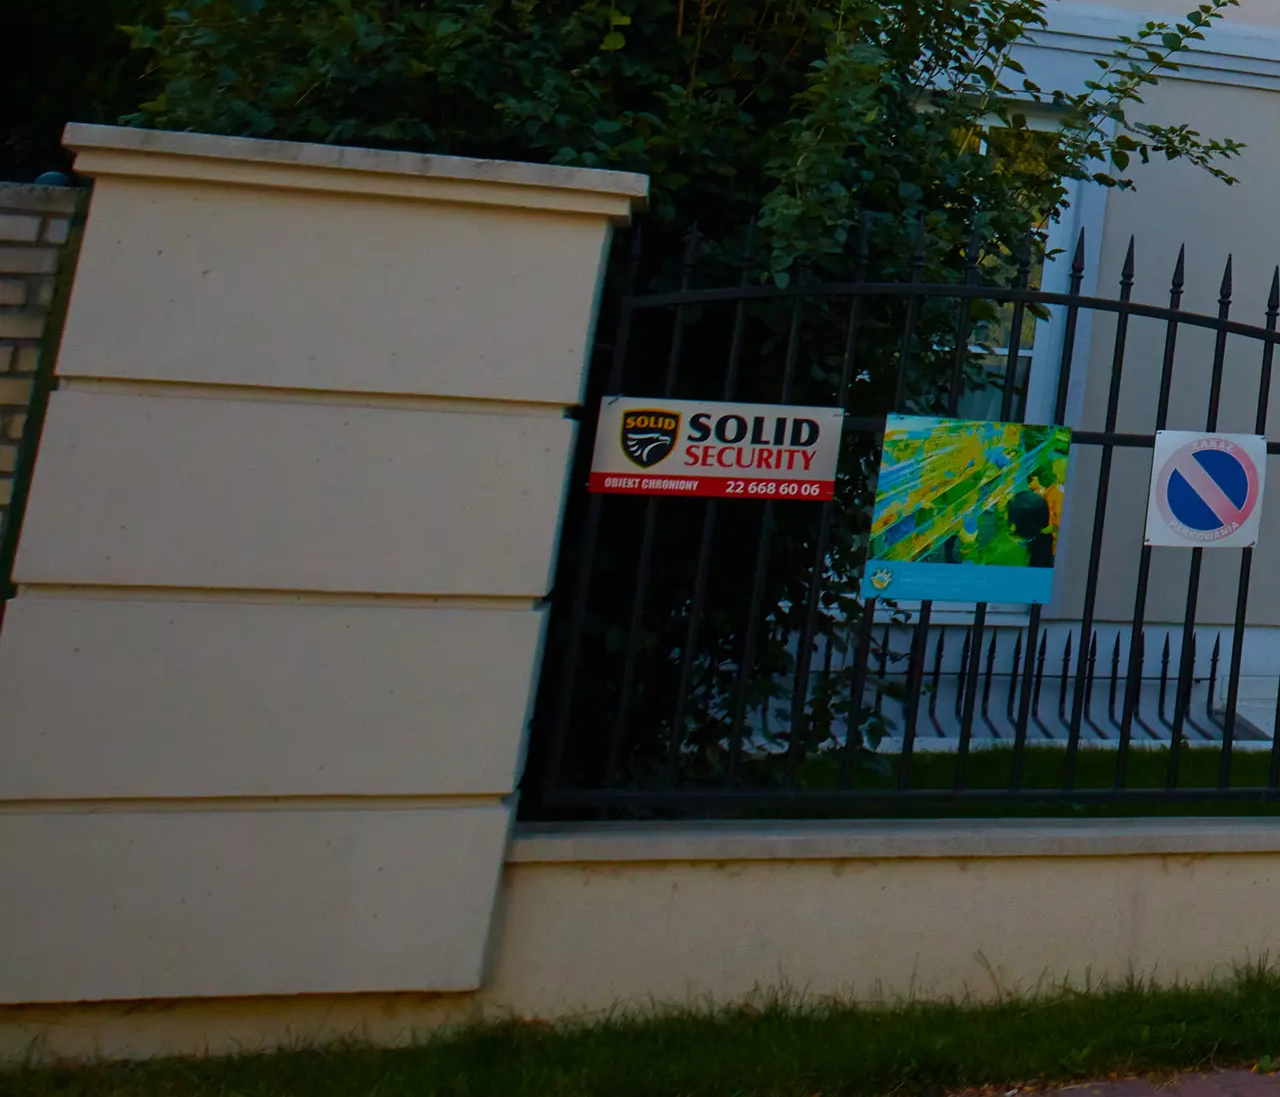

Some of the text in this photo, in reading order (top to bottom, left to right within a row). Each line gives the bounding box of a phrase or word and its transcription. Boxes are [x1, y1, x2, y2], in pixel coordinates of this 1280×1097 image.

[624, 414, 676, 431] SOLID
[687, 412, 820, 447] SOLID
[1192, 439, 1235, 451] ZAKAZ
[684, 445, 817, 471] SECURITY
[604, 477, 700, 491] OBIEKT CHRONIONY
[725, 481, 820, 496] 22 668 60 06
[1168, 521, 1240, 541] PARKOWANIA
